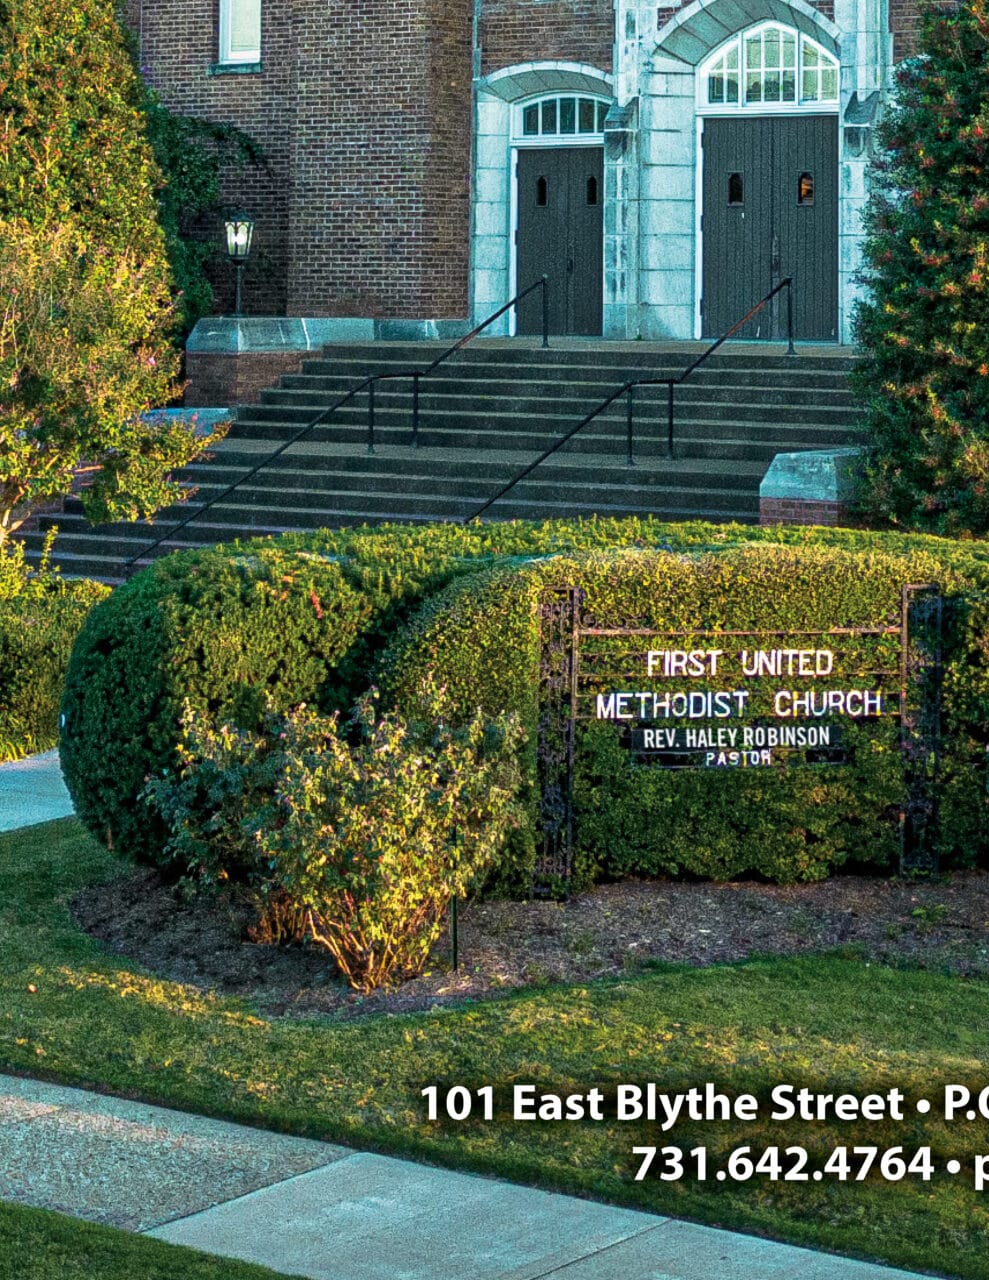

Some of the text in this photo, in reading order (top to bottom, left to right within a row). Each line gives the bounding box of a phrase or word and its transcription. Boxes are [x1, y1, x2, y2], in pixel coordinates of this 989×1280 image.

[645, 648, 833, 677] FIRST UNITED
[595, 690, 881, 720] METHODIST CHURCH
[643, 726, 830, 749] REV. HALEY ROBINSON
[705, 749, 772, 766] PASTOR
